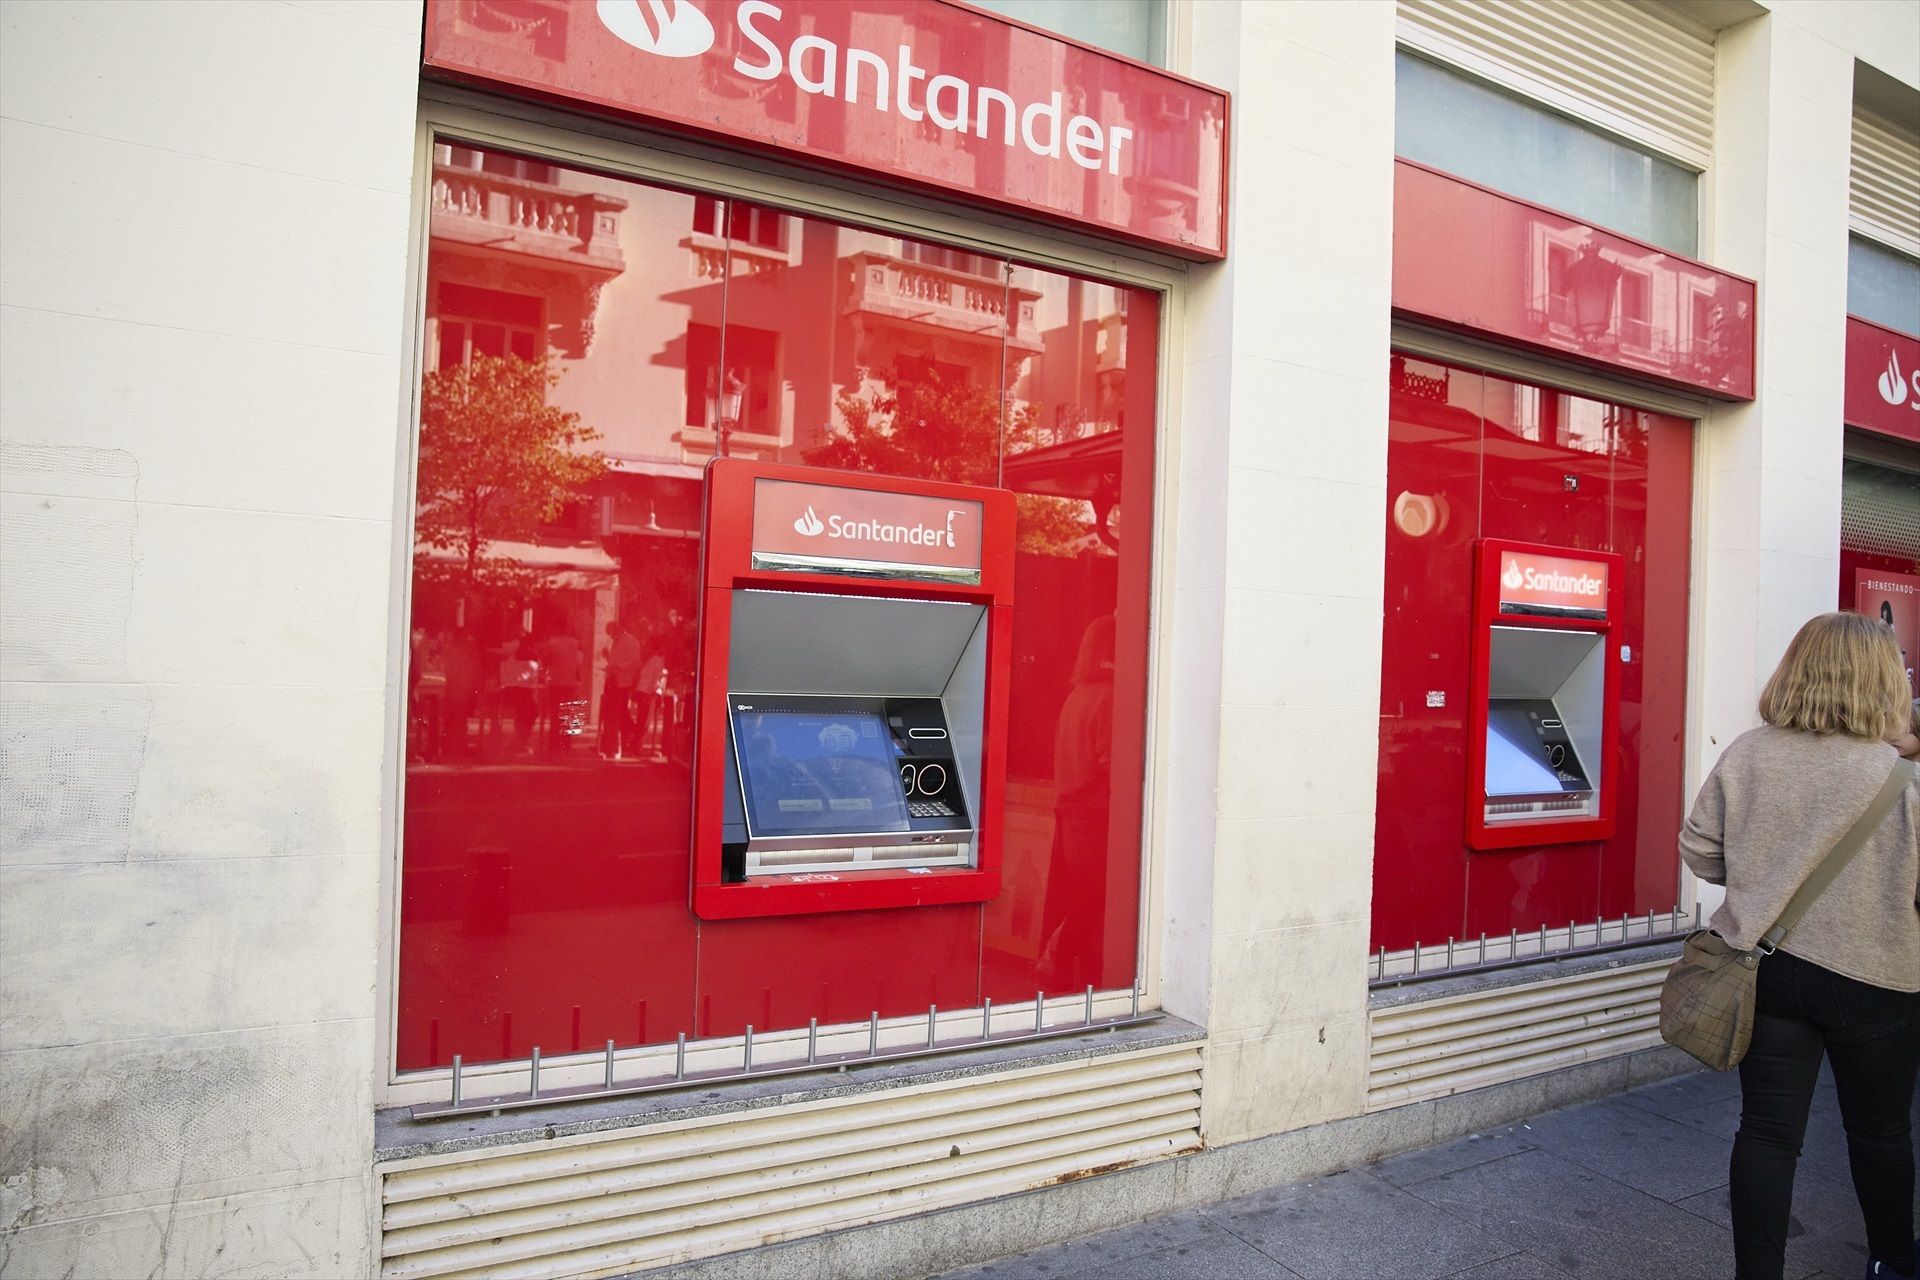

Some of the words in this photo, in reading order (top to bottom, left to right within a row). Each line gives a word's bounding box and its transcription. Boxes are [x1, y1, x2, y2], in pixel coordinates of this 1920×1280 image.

[733, 0, 1133, 176] Santander
[828, 514, 945, 547] Santander
[1524, 567, 1602, 595] Santander
[1867, 579, 1914, 594] BIENESTANDO
